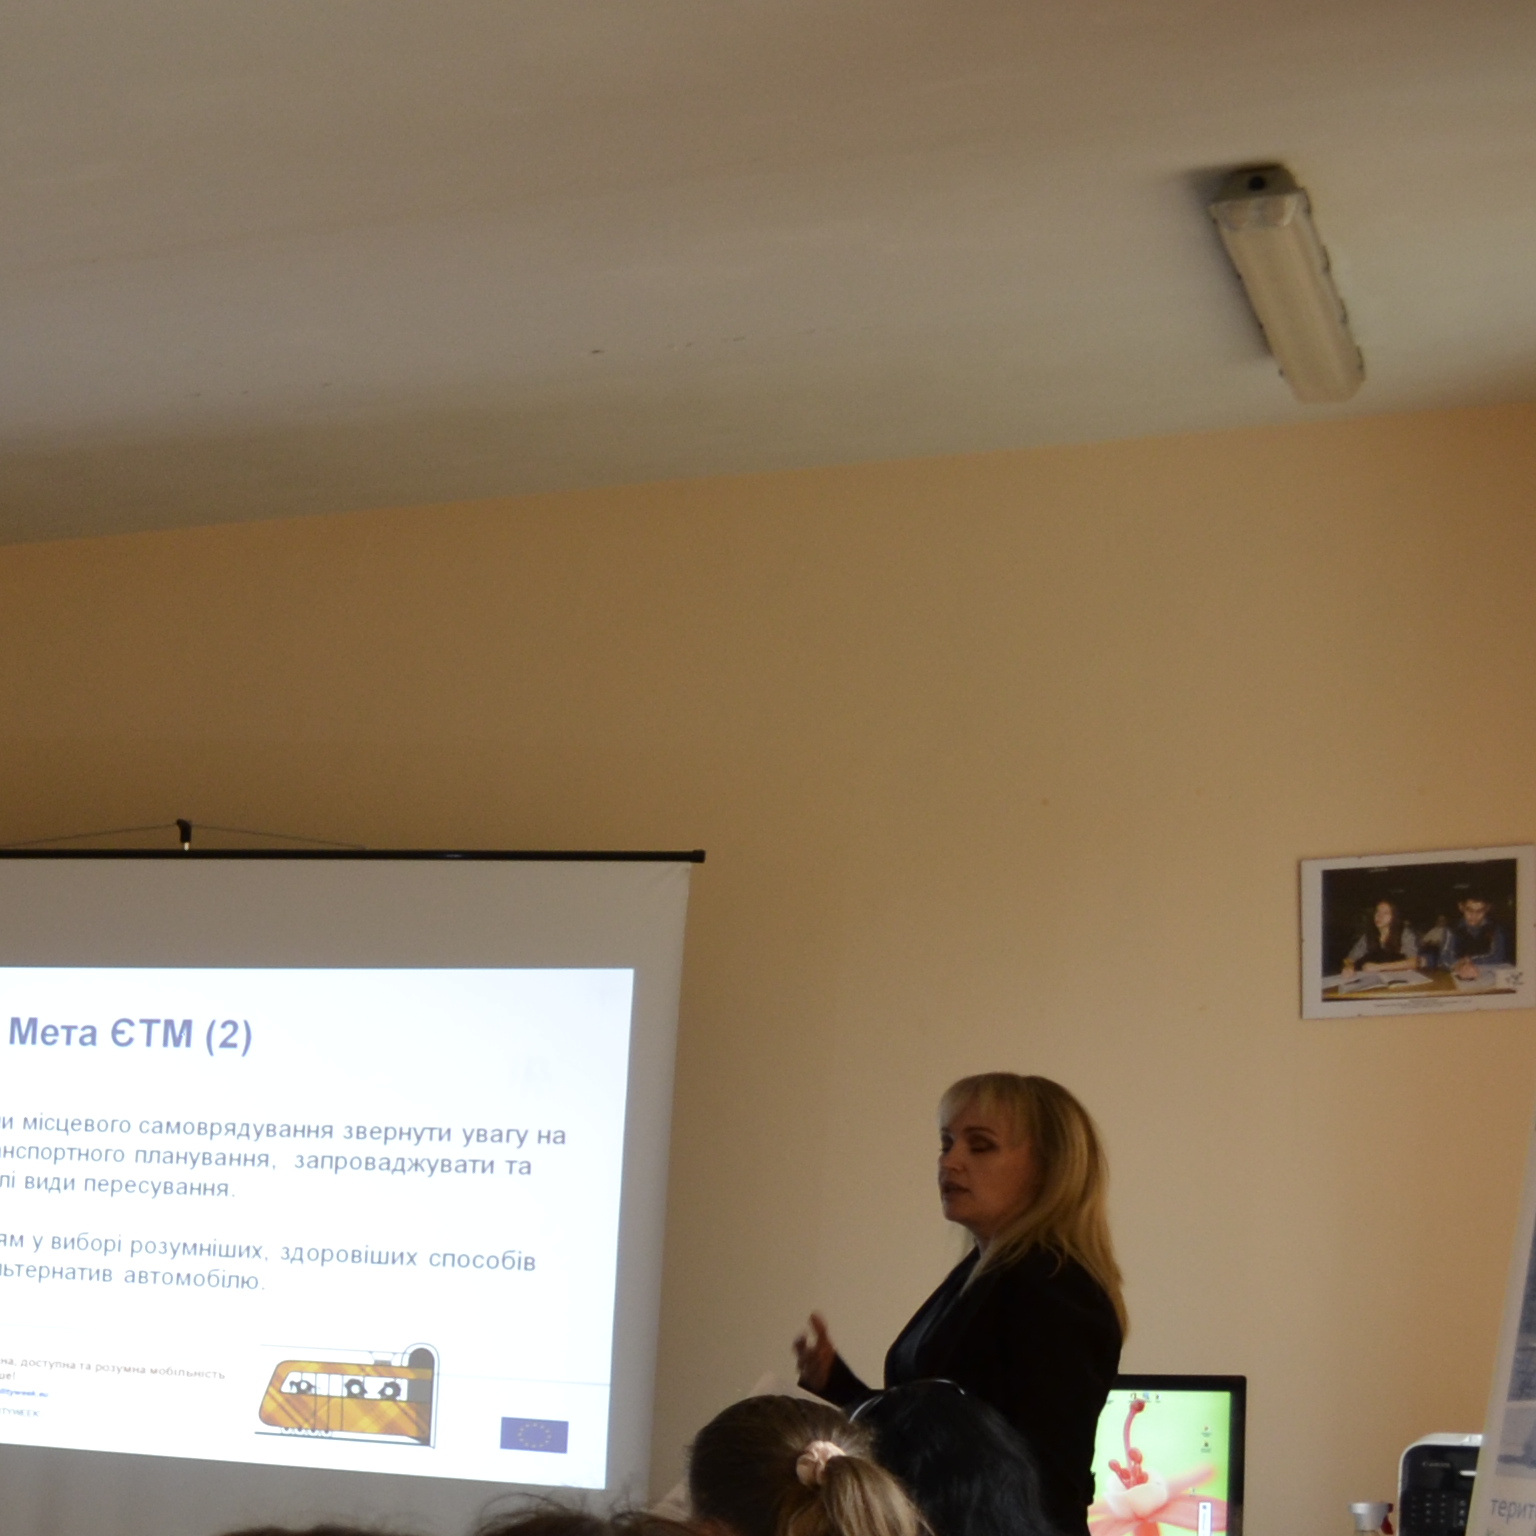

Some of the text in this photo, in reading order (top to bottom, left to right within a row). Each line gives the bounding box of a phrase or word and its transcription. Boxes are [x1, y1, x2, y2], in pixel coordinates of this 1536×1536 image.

[9, 1016, 253, 1057] Мета ЄТМ (2)
[22, 1112, 132, 1135] місцевого
[139, 1119, 333, 1142] самоврядування
[342, 1124, 452, 1146] звернути
[462, 1127, 529, 1149] увагу
[537, 1128, 567, 1145] на
[135, 1148, 277, 1171] планування,
[294, 1153, 495, 1177] запроваджувати
[506, 1159, 532, 1175] та
[24, 1174, 75, 1194] види
[84, 1176, 235, 1199] пересування.
[32, 1234, 44, 1253] у
[51, 1232, 122, 1256] виборі
[131, 1236, 269, 1262] розумніших,
[280, 1243, 418, 1267] здоровіших
[429, 1250, 536, 1272] способів
[124, 1268, 266, 1291] автомобілю.
[20, 1358, 76, 1370] доступна
[80, 1362, 91, 1371] та
[95, 1364, 146, 1375] розумна
[150, 1366, 226, 1380] мобільність
